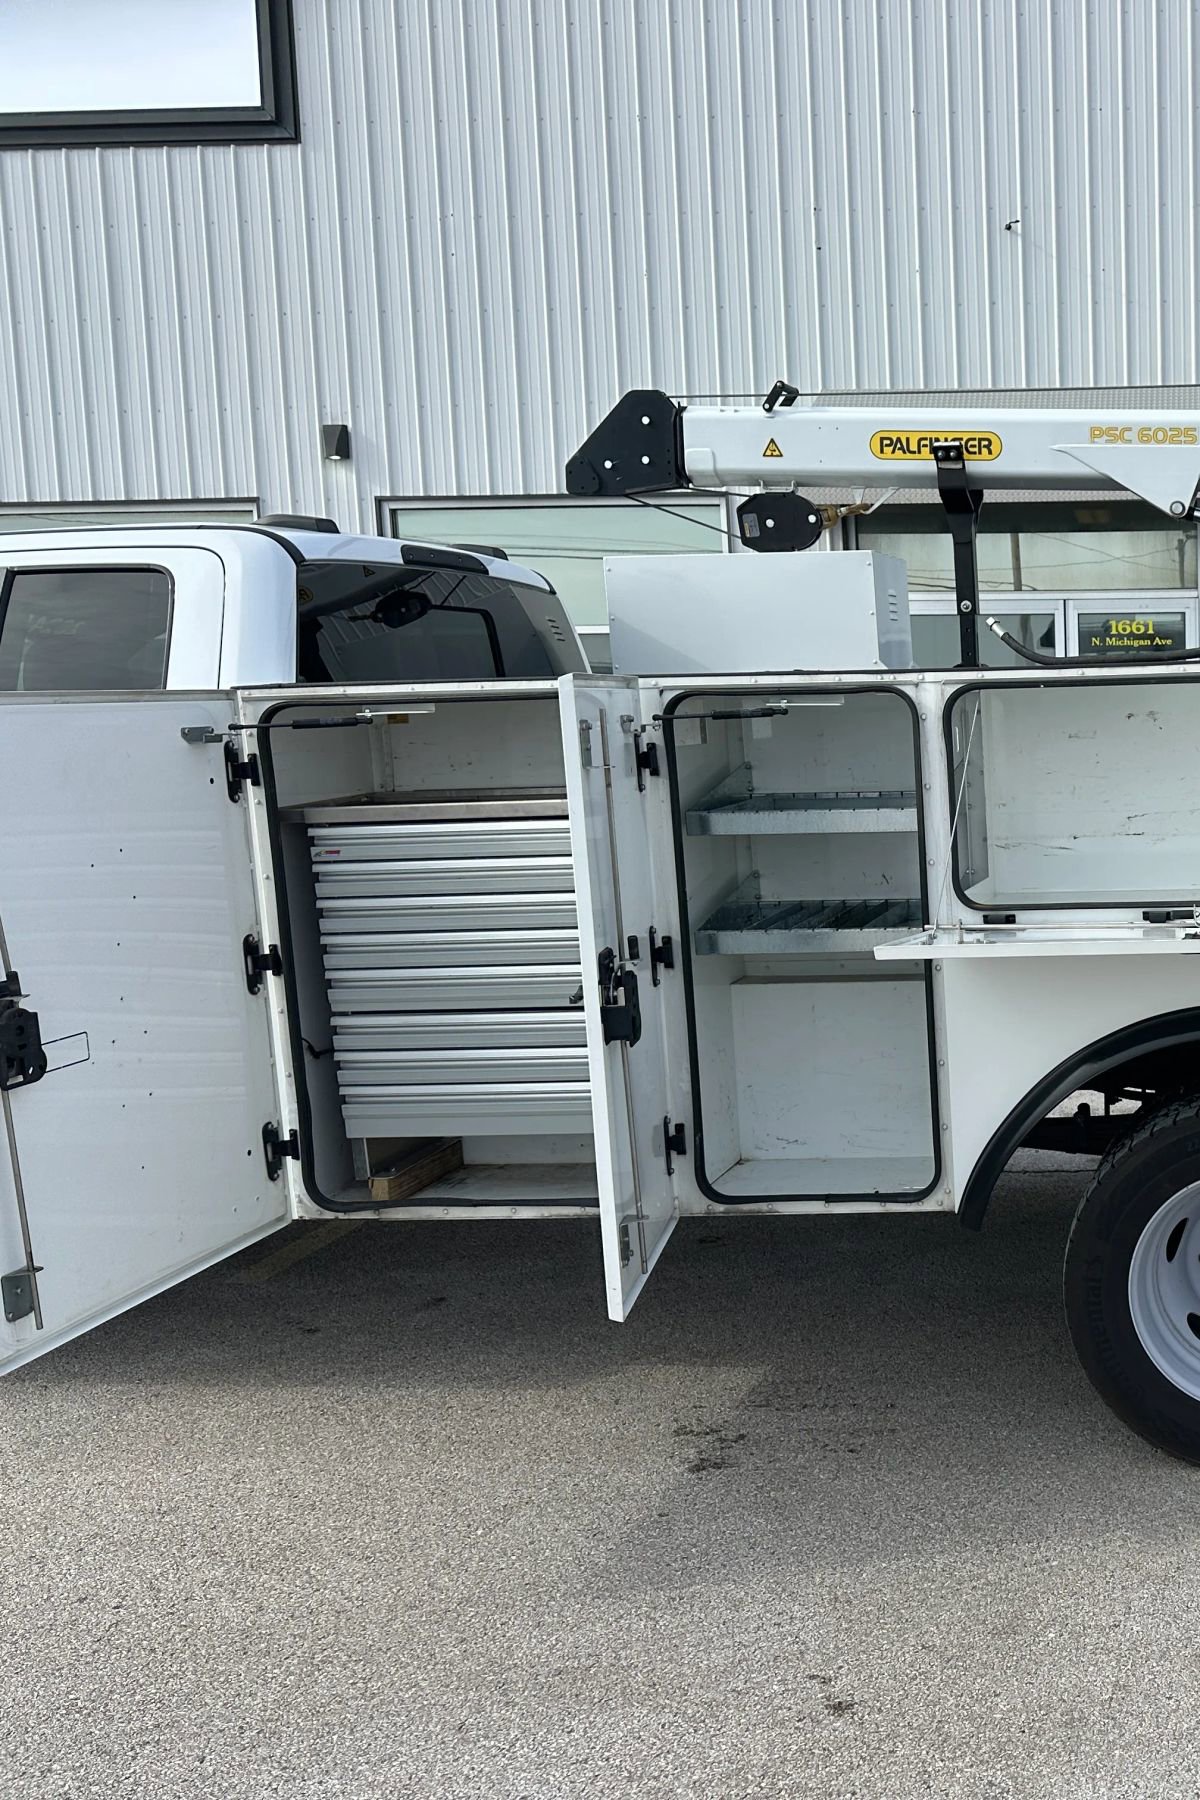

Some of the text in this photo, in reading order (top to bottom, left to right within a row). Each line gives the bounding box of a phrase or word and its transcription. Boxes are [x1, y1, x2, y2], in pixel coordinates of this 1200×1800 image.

[1089, 426, 1198, 445] PSC 6025
[879, 436, 993, 456] PALFIER
[1108, 619, 1155, 635] 1661
[1091, 636, 1173, 648] N. Michigan Ave
